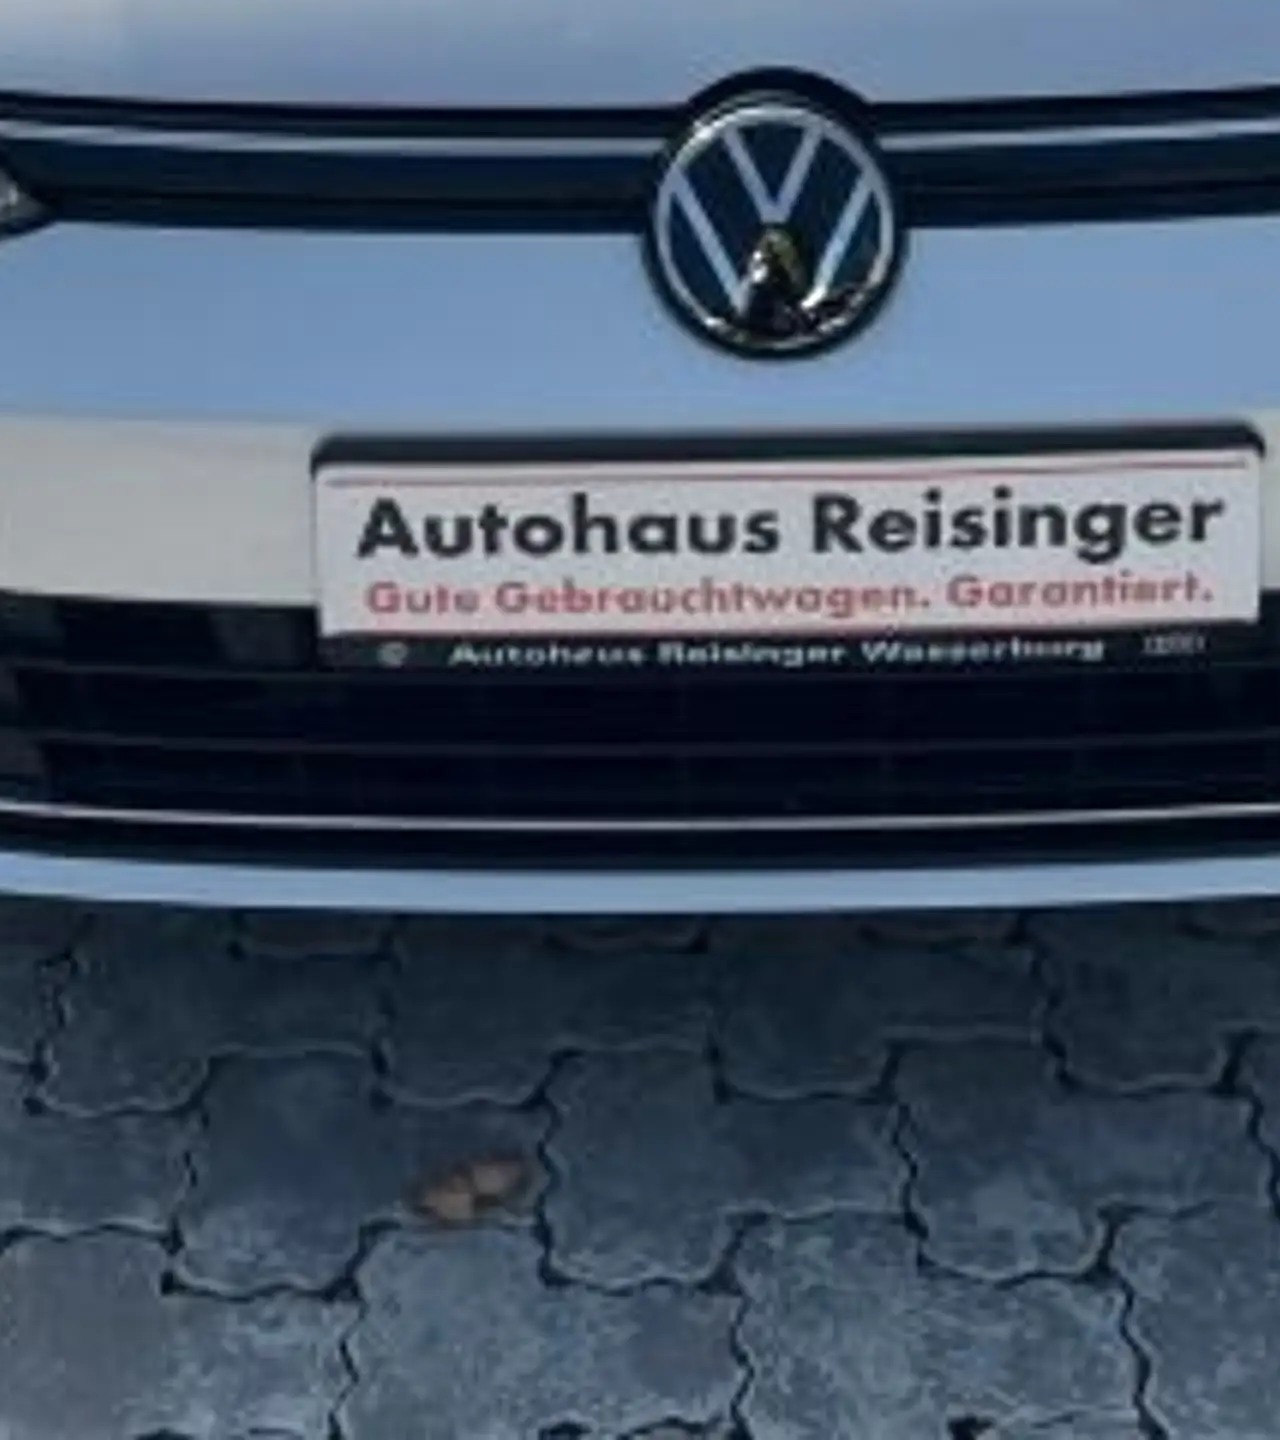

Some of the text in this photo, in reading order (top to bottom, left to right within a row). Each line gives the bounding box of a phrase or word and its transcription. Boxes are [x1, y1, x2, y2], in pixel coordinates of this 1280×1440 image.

[357, 485, 1226, 565] Autohaus Reisinger
[365, 569, 1214, 618] Gute Gebrauchtwagen. Garantiert.
[448, 641, 645, 667] Autohaus
[658, 640, 846, 668] Reisinger
